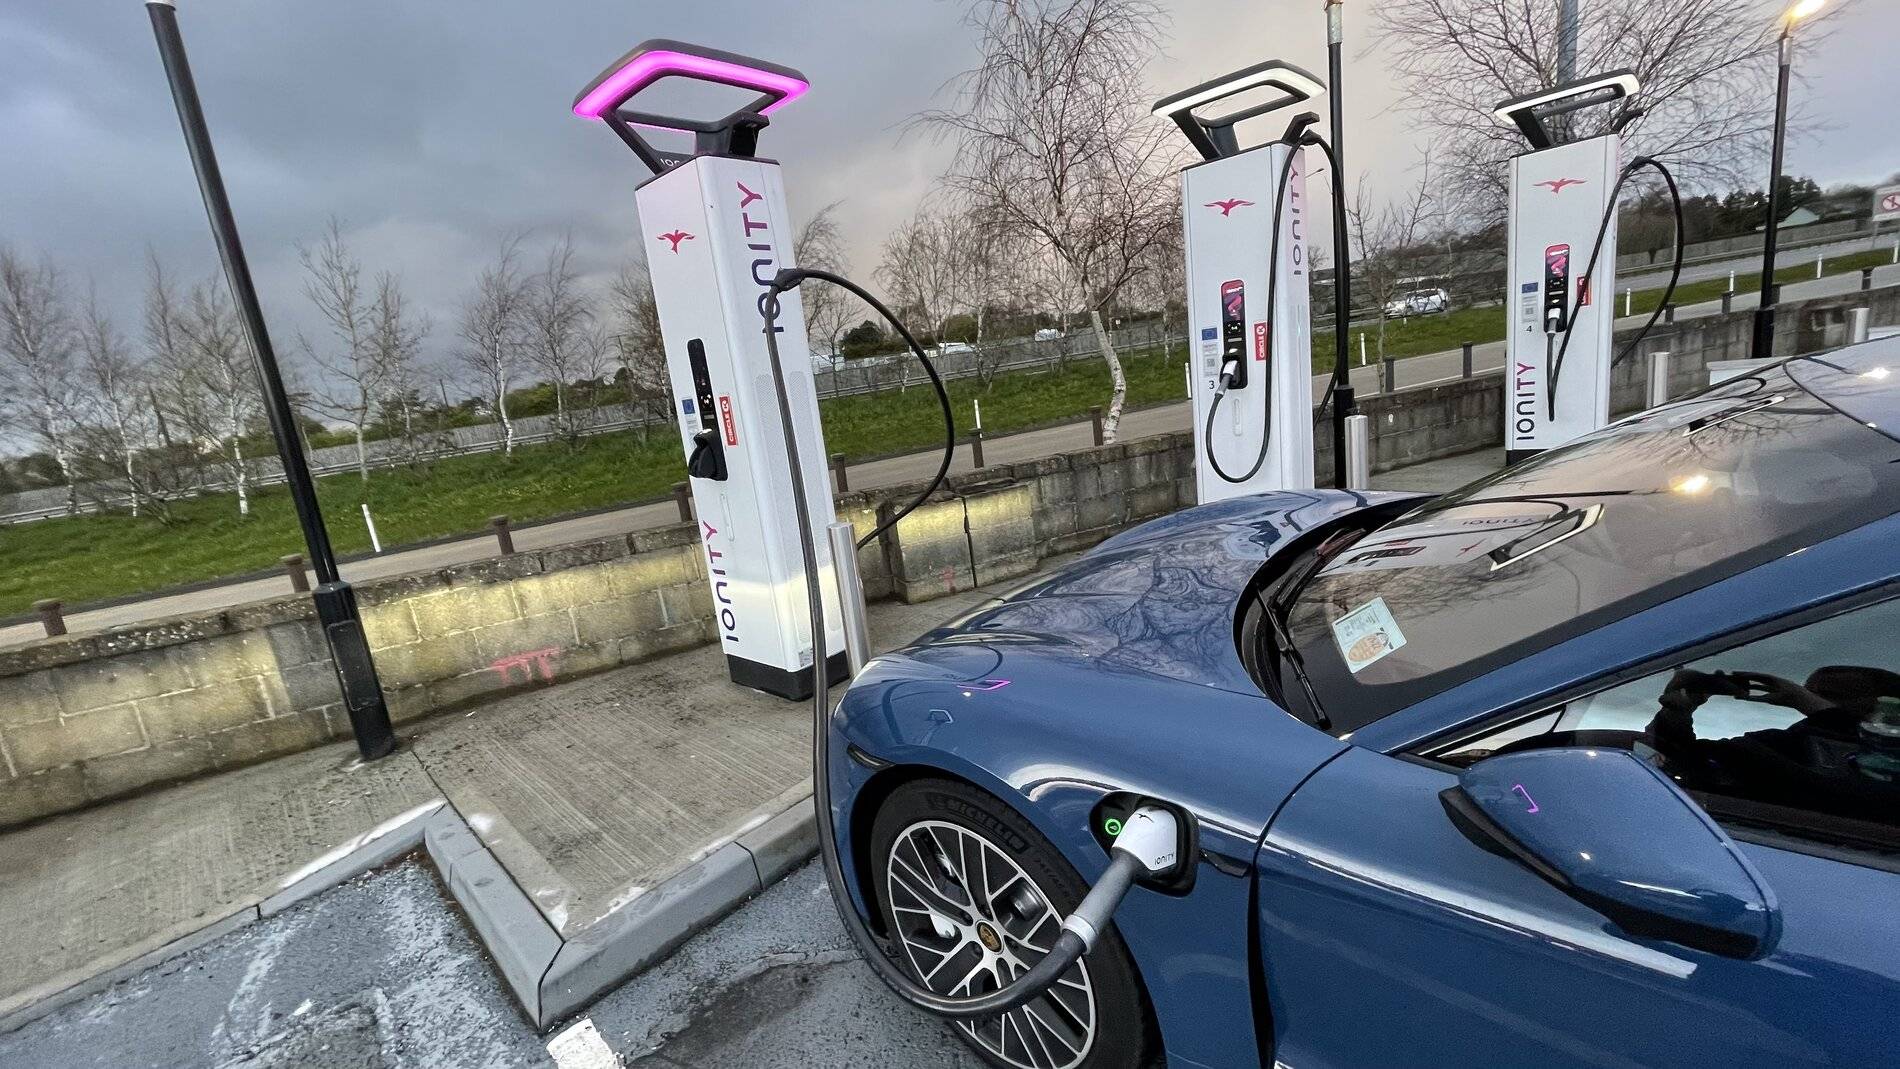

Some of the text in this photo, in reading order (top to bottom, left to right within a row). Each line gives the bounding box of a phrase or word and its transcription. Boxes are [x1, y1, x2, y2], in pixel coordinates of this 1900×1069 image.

[737, 181, 784, 334] IONITY
[1290, 163, 1302, 276] IONITY
[724, 412, 734, 442] CIRCLE
[1208, 380, 1215, 389] 3
[1516, 362, 1536, 441] IONITY
[703, 520, 739, 642] IONITY
